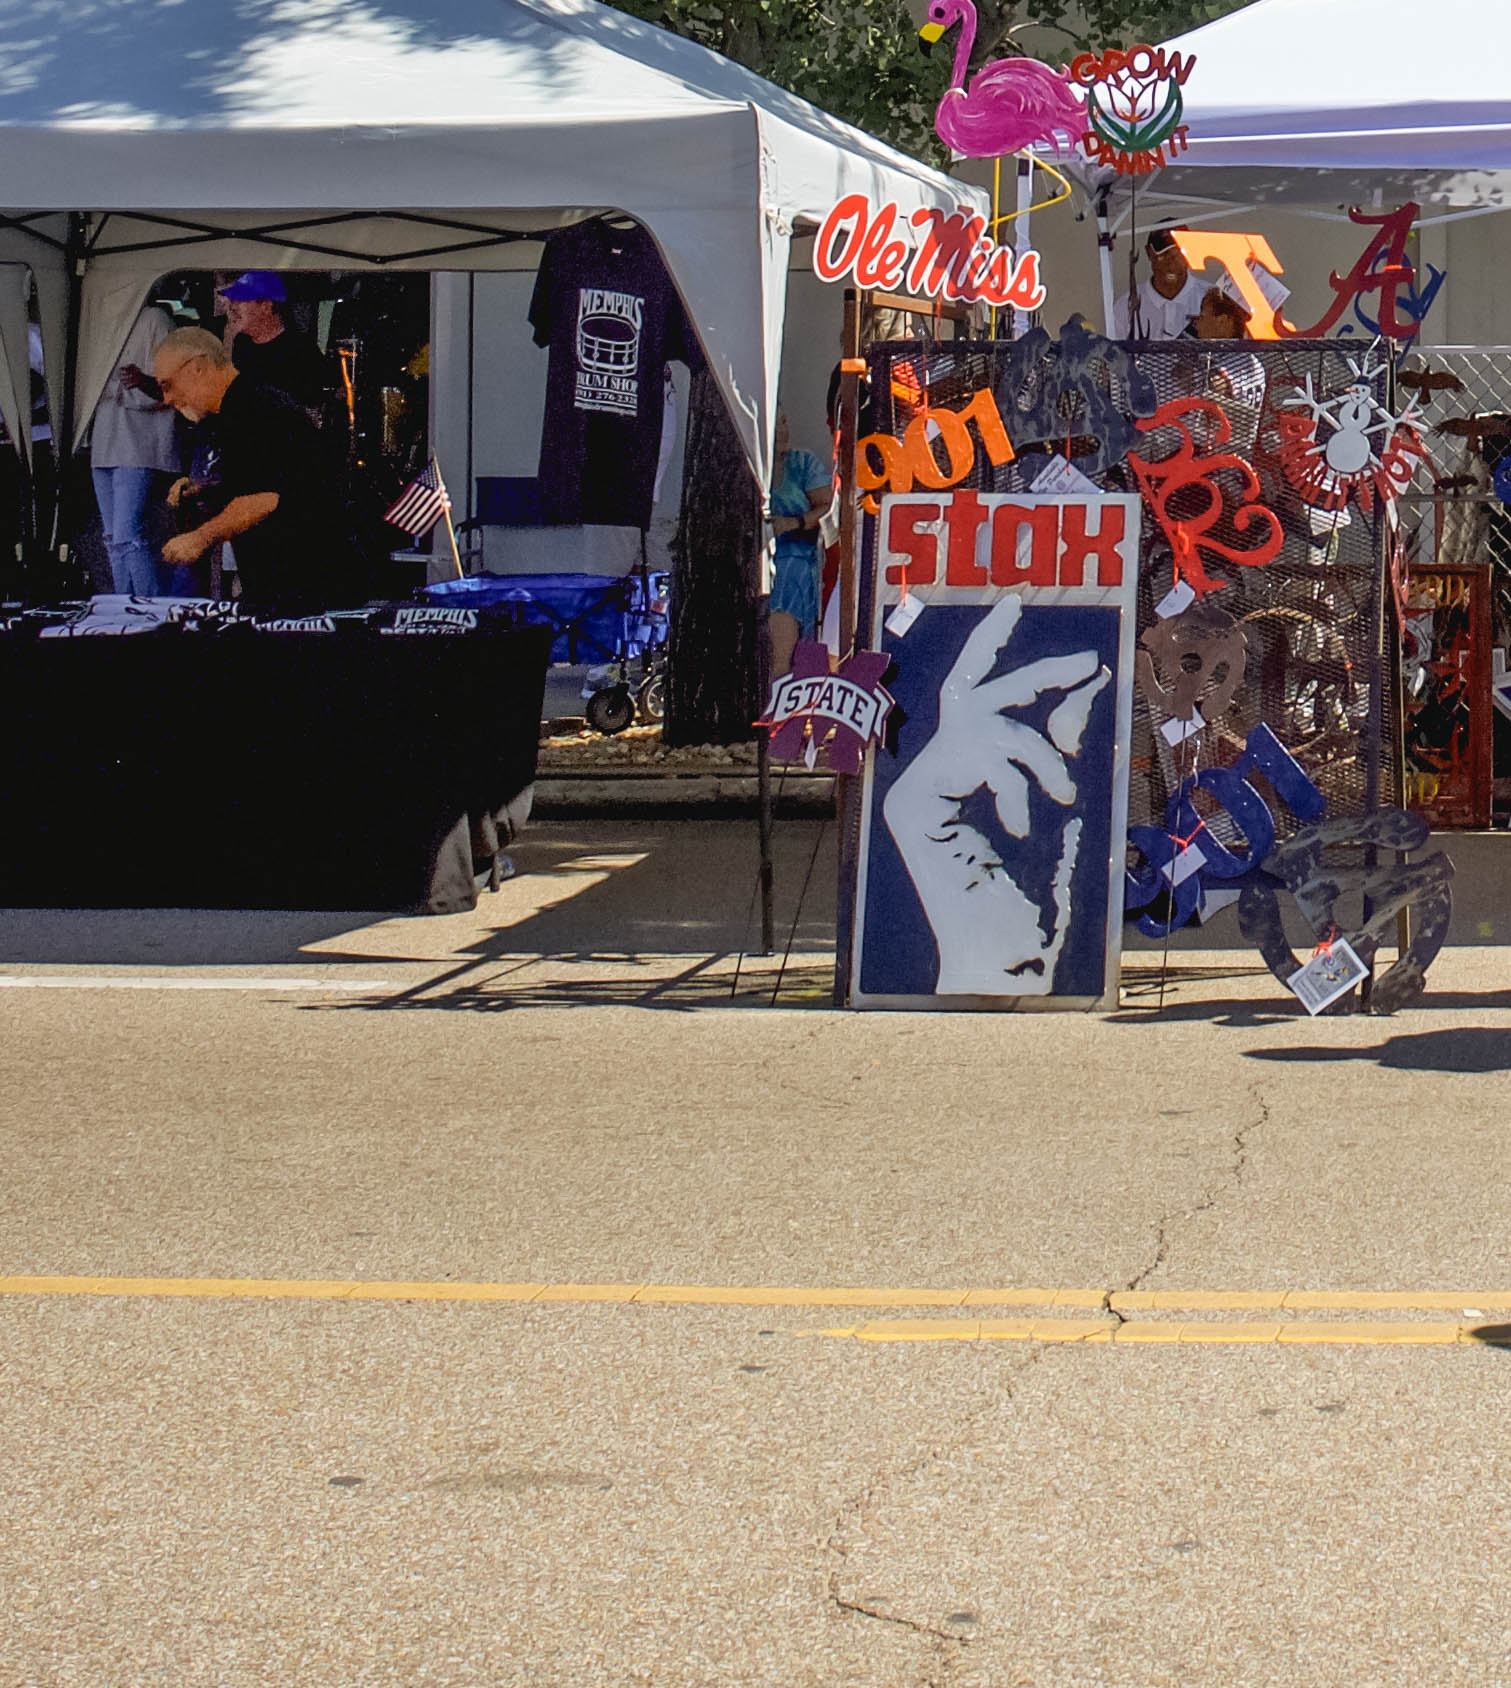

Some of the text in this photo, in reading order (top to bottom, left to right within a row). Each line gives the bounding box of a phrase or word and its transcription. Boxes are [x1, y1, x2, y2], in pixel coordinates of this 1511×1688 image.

[1070, 43, 1197, 88] GROW
[817, 194, 1046, 310] Ole Miss
[579, 288, 646, 330] MEMPHIS
[856, 387, 1016, 515] 901
[886, 489, 1126, 587] stax
[394, 607, 480, 629] MEMPHIS
[783, 682, 869, 729] STATE
